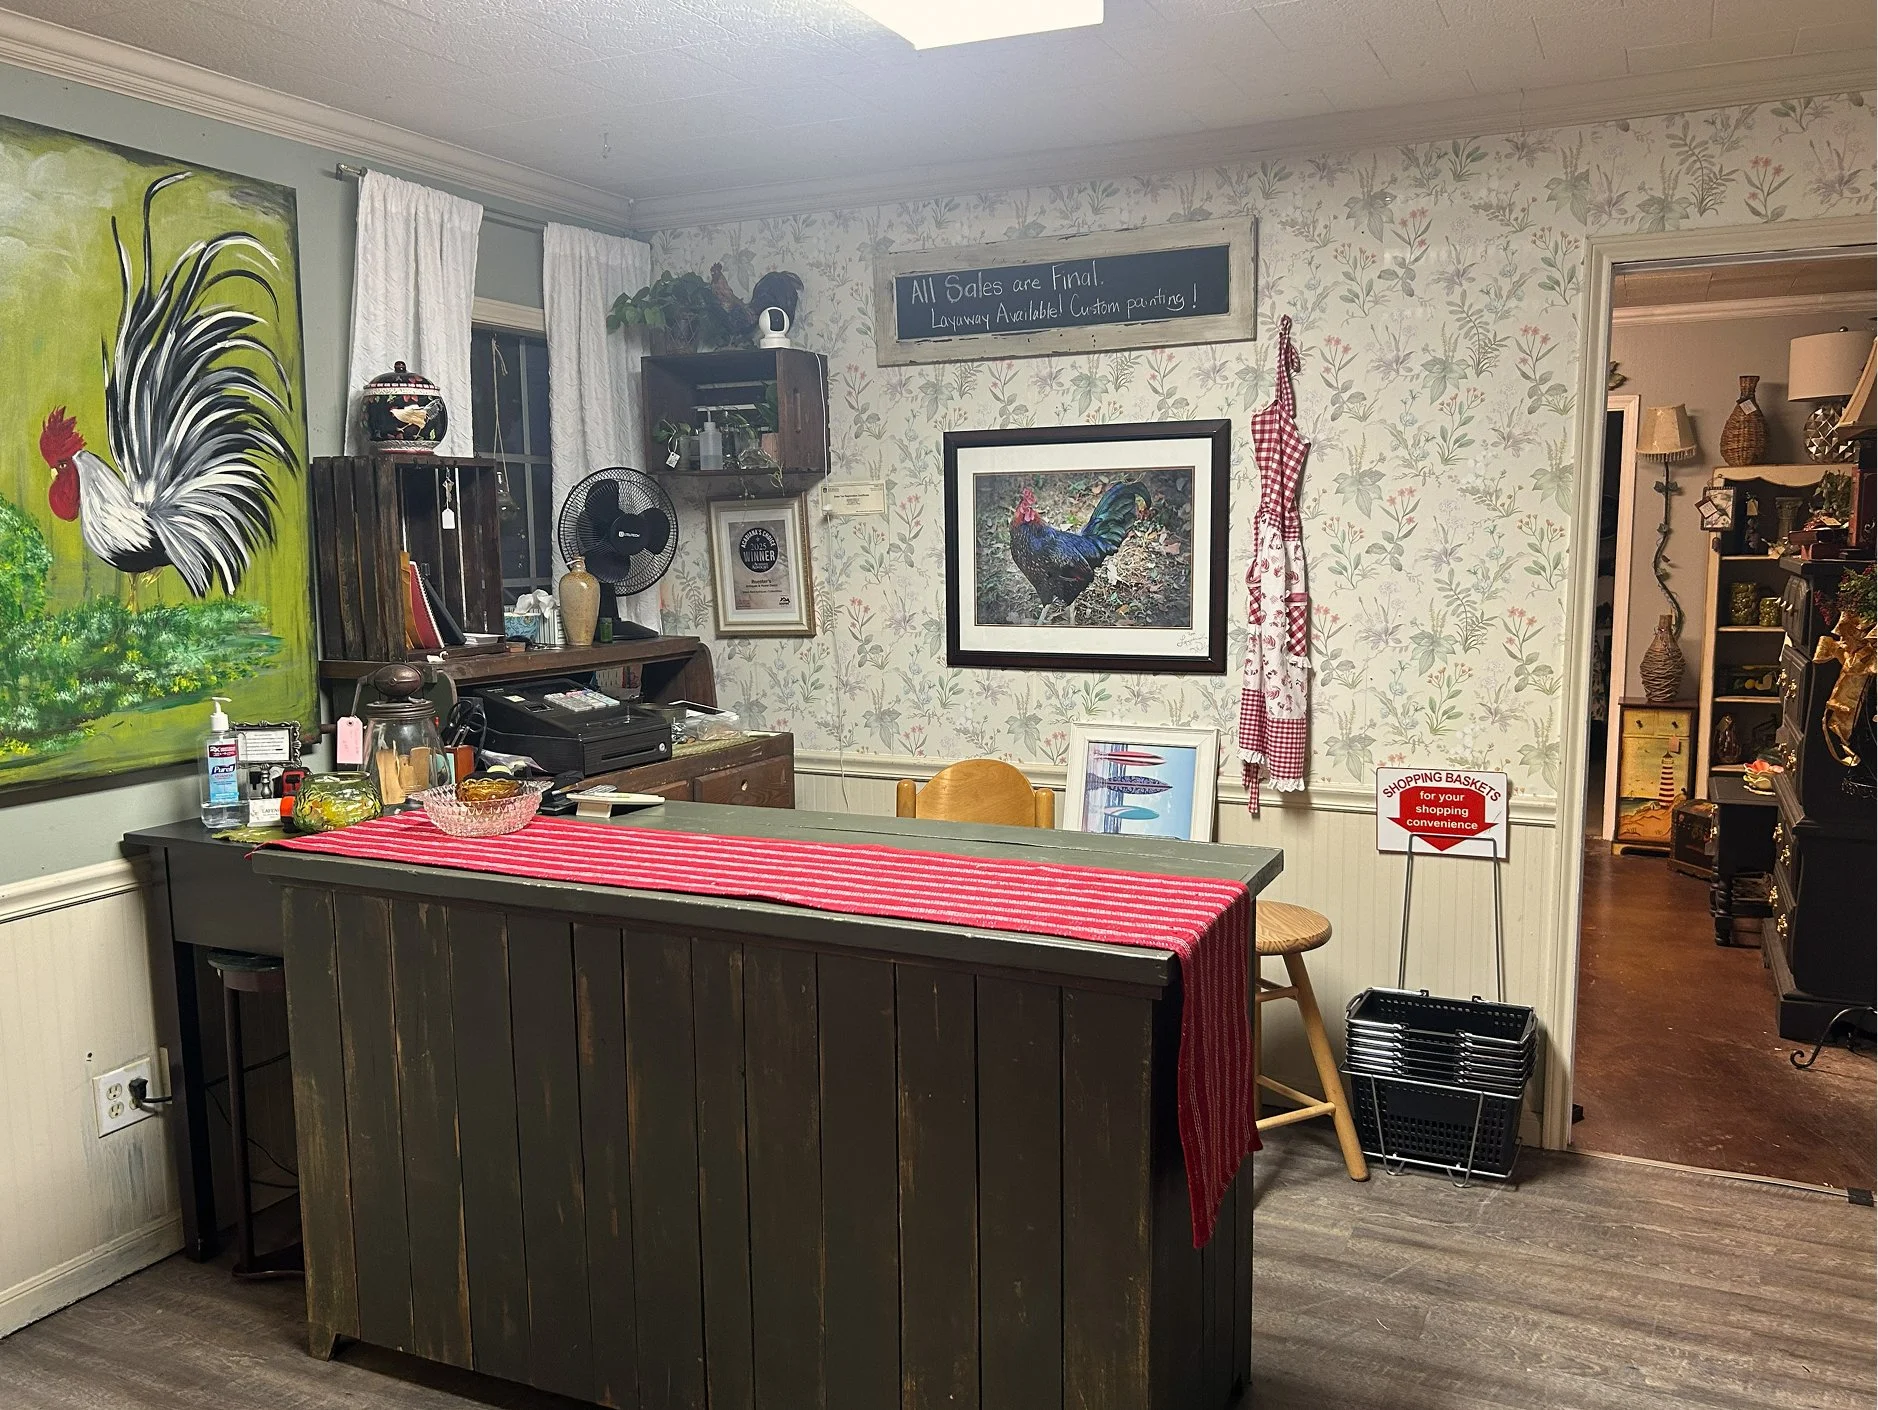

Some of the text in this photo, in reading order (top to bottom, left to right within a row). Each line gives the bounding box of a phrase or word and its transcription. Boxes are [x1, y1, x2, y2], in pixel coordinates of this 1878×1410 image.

[911, 260, 1105, 304] All Sales are Final.
[930, 307, 990, 332] Layaway
[996, 297, 1063, 324] Available!
[1070, 294, 1120, 318] Custom
[750, 543, 767, 551] 2025
[743, 550, 776, 562] WINNER
[1382, 771, 1501, 802] SHOPPING BASKETS
[1419, 790, 1466, 803] for your
[1415, 804, 1470, 818] shopping
[1406, 819, 1479, 831] convenience
